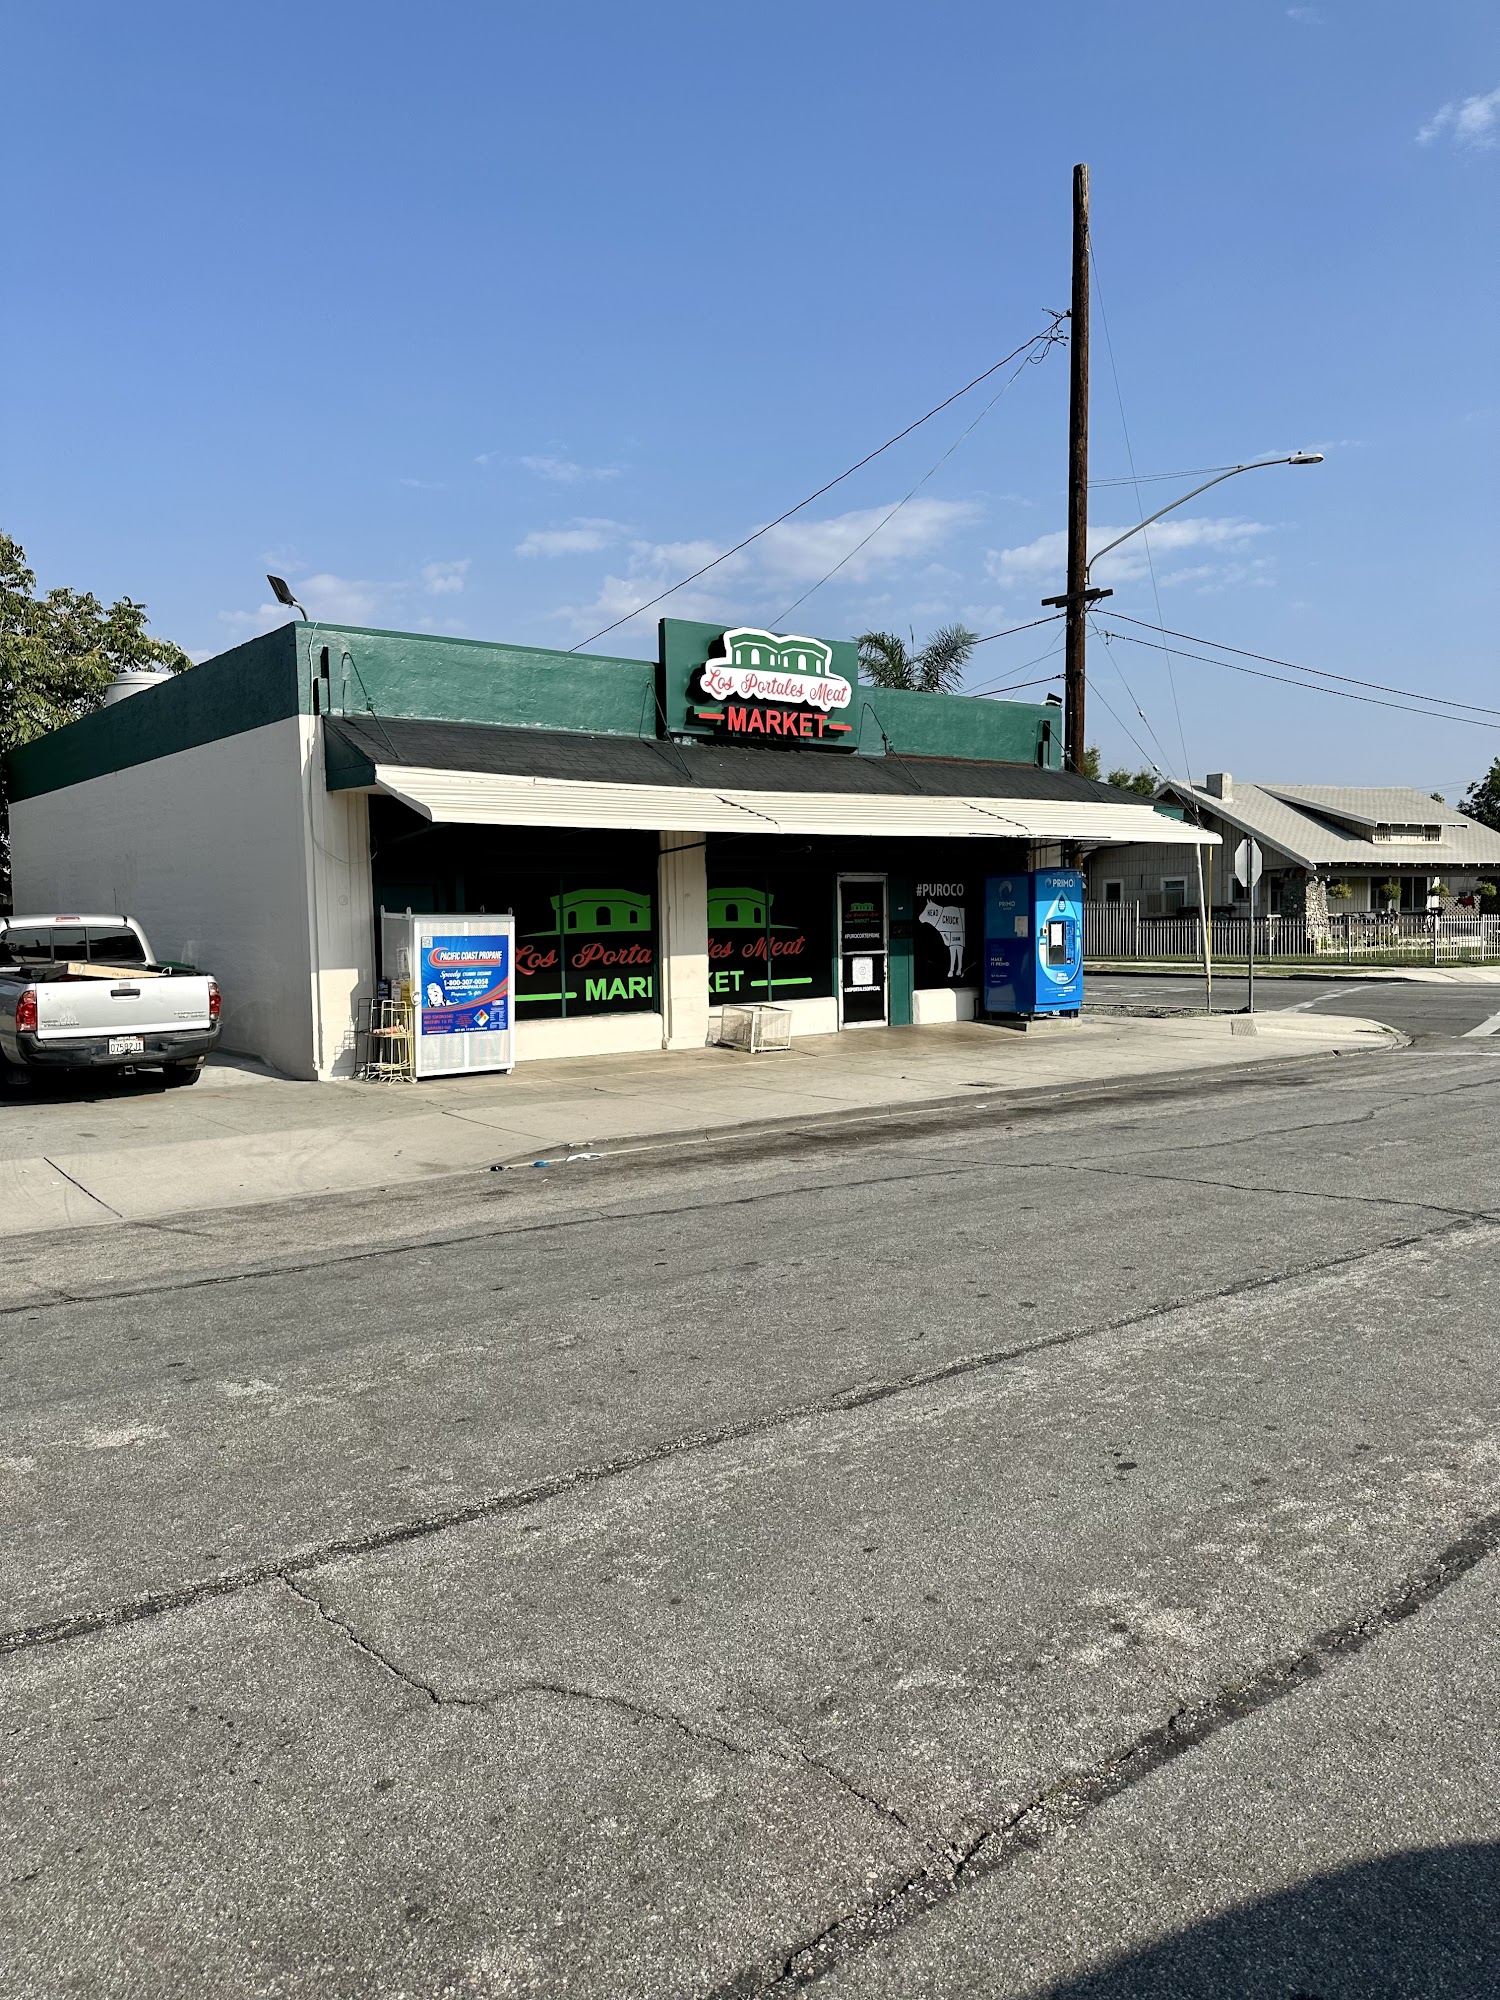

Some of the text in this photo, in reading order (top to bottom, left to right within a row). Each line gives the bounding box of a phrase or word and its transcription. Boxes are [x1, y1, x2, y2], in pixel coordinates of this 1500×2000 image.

[704, 668, 848, 704] Los Portales Meat
[727, 705, 828, 738] MARKET
[916, 883, 964, 897] #PUROCO
[1052, 878, 1074, 888] PRIMO
[927, 909, 939, 917] HEAD
[942, 915, 960, 925] CHUCK
[440, 950, 502, 960] PACIFIC COAST PROPANE
[742, 936, 806, 961] Meat
[515, 945, 559, 975] Los
